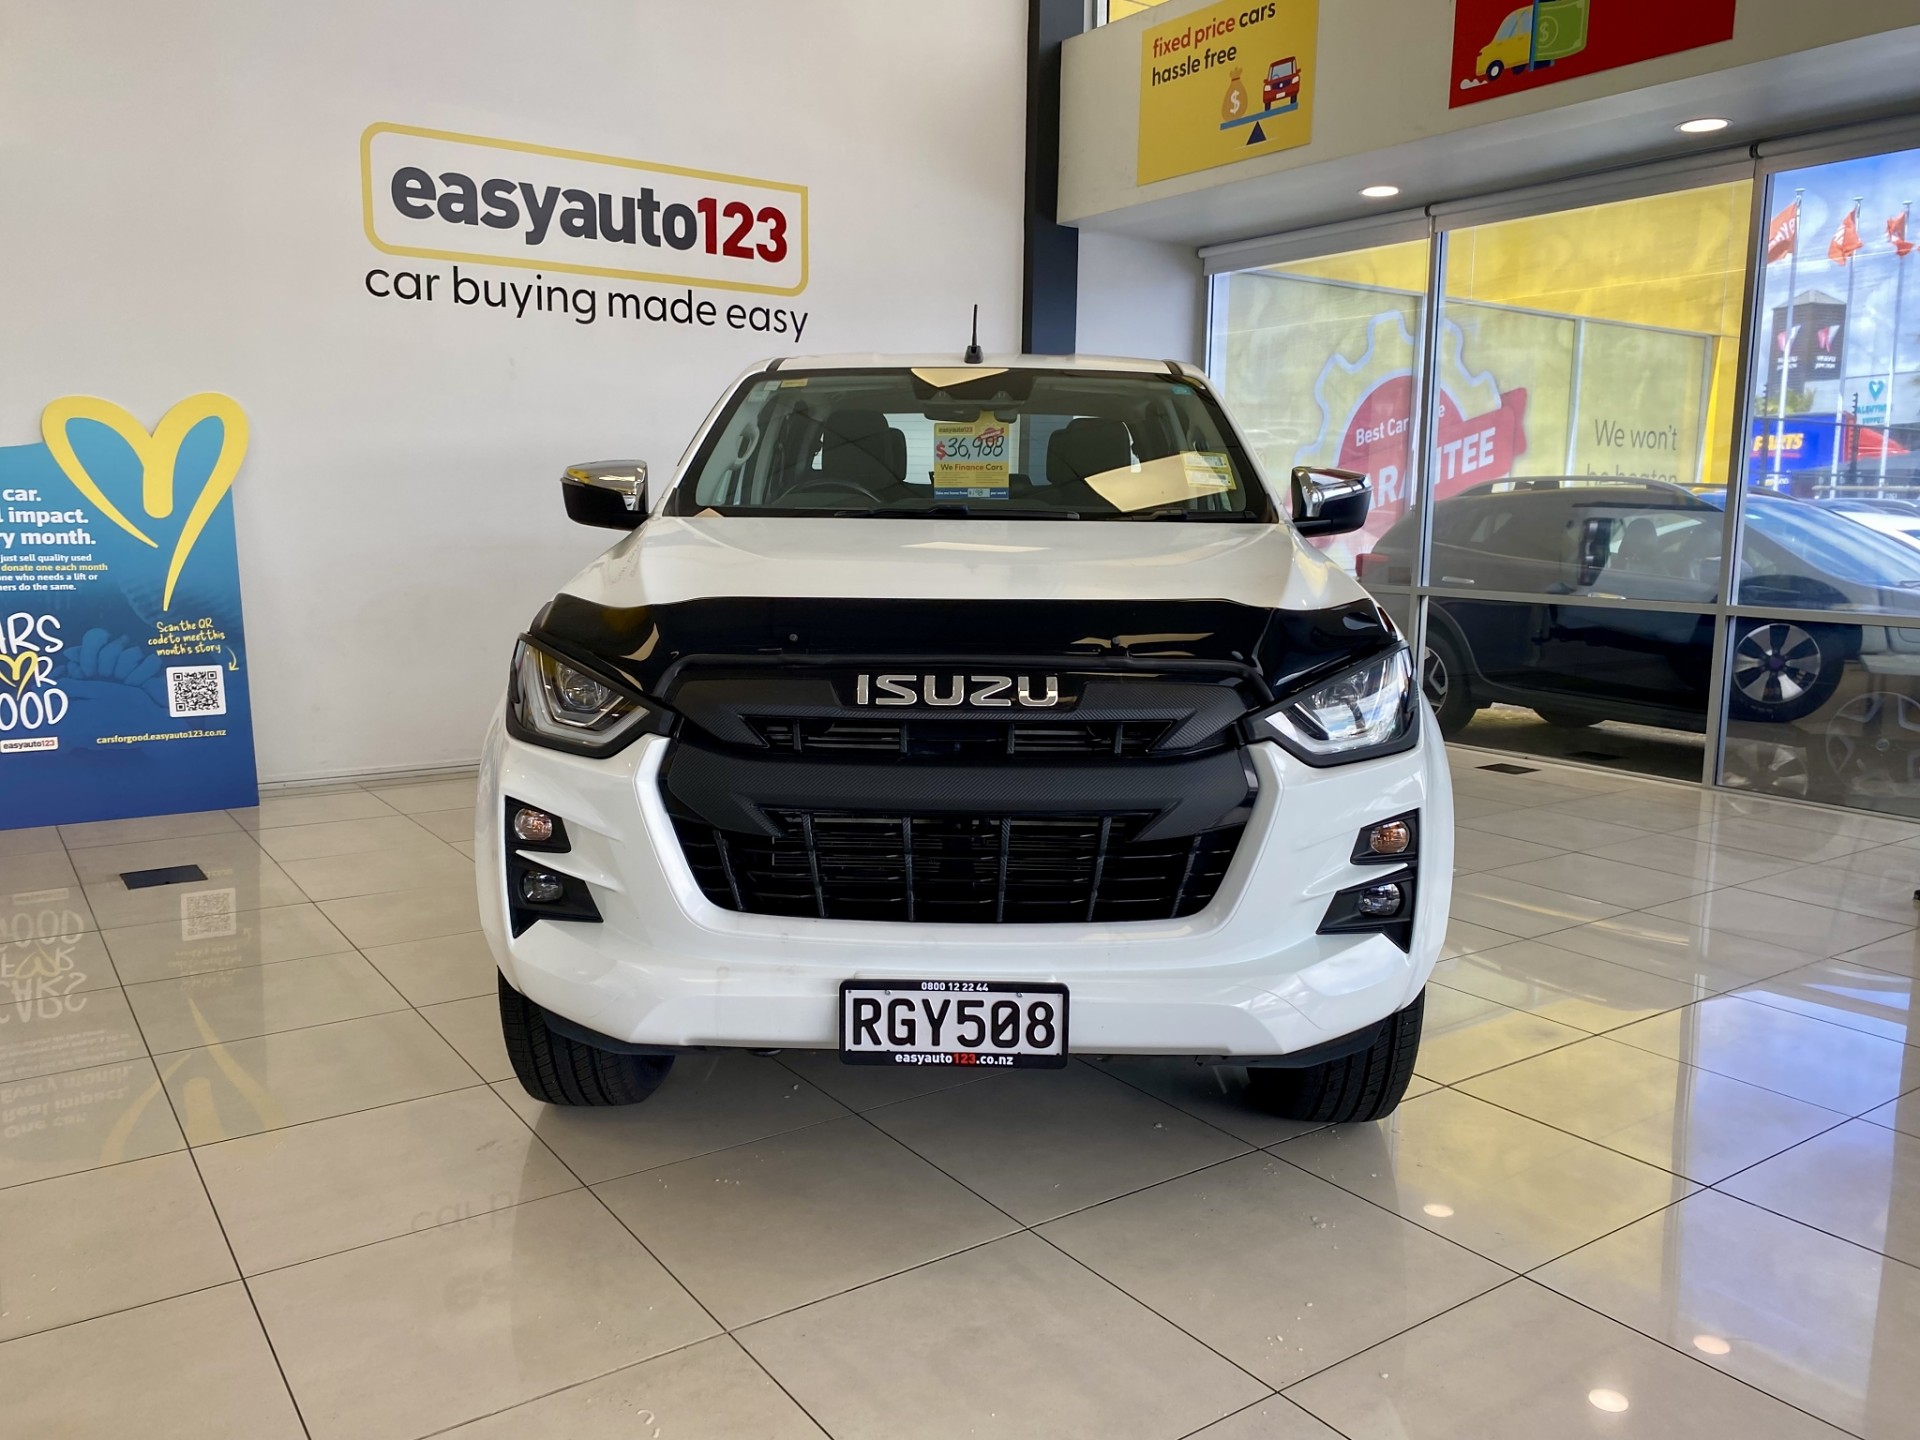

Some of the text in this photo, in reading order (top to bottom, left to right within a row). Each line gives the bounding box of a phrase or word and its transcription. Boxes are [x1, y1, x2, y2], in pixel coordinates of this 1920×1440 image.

[1153, 2, 1276, 58] fixed price cars
[1152, 46, 1237, 86] hassle free
[391, 165, 787, 263] easyauto123
[365, 266, 809, 343] car buying made easy
[1356, 422, 1385, 447] Best
[1595, 419, 1678, 451] We won't
[2, 489, 42, 501] car.
[8, 507, 89, 527] impact.
[21, 528, 96, 545] month.
[0, 553, 92, 563] just sell quality used
[55, 563, 77, 571] each
[79, 563, 109, 571] month
[15, 573, 35, 581] who
[37, 573, 64, 581] needs
[74, 572, 86, 581] lift
[18, 583, 30, 591] do
[33, 583, 48, 591] the
[156, 617, 214, 632] Scan the QR
[148, 629, 225, 645] code to meet this
[156, 641, 221, 656] month's story
[857, 674, 1059, 707] ISUZU
[3, 738, 55, 749] easyauto123
[96, 729, 226, 744] carsforgood.easyauto123.co.nz
[921, 981, 989, 992] 0800 12 22 44
[853, 997, 1056, 1049] RGY508
[895, 1052, 1014, 1066] easyauto123.co.nz
